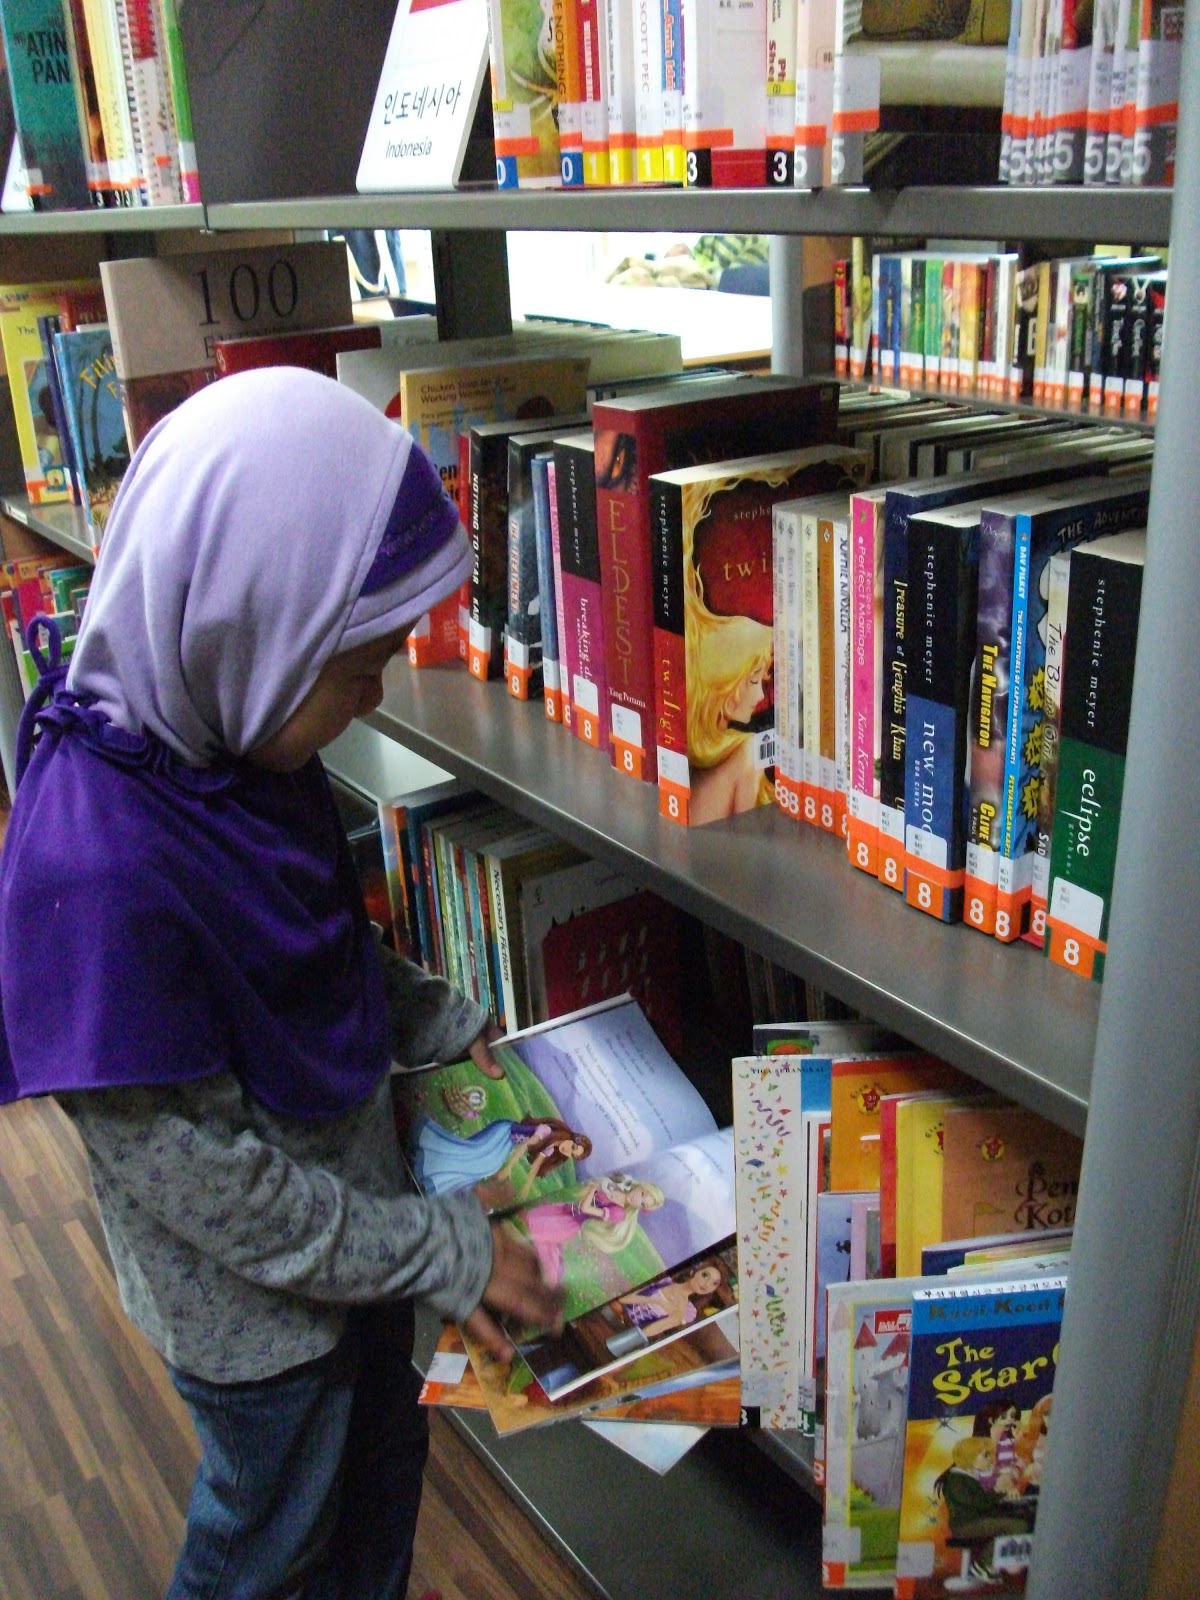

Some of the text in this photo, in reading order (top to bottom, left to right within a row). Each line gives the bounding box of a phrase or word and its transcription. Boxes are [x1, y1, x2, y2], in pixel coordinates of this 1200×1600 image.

[639, 1, 650, 58] SCOTT
[664, 13, 675, 59] Amin
[553, 15, 567, 96] NOTHING
[382, 80, 462, 126] 인도네시아
[385, 136, 433, 160] Indonesia
[664, 149, 675, 179] 1
[794, 144, 807, 177] 5
[831, 138, 845, 174] 5
[1009, 139, 1026, 177] 5
[1053, 131, 1075, 171] 5
[1084, 135, 1105, 176] 5
[1106, 133, 1122, 173] 5
[1133, 131, 1152, 175] 5
[561, 156, 573, 183] 0
[589, 153, 598, 180] 1
[642, 152, 652, 181] 1
[687, 151, 698, 183] 3
[773, 151, 787, 183] 3
[191, 259, 299, 327] 100
[17, 326, 36, 335] The
[420, 382, 455, 394] Chicken
[420, 391, 457, 404] Working
[472, 472, 480, 535] NOTHING
[569, 459, 583, 566] stephenie meyer
[473, 534, 480, 551] TO
[1056, 520, 1084, 543] THE
[510, 518, 520, 616] THE TREATMENT
[660, 495, 671, 618] stephenie meyer
[722, 551, 768, 582] twi
[1020, 545, 1028, 567] DAV
[608, 499, 633, 686] ELDEST
[864, 570, 872, 614] Recipes
[1019, 568, 1028, 600] PILKEY
[855, 546, 867, 666] Perfect Marriage
[924, 545, 937, 685] stephenie meyer
[578, 598, 591, 662] breaking
[1047, 622, 1062, 656] The
[408, 645, 418, 666] 8
[472, 656, 481, 675] 8
[1014, 625, 1023, 677] ADVENTURES
[1086, 579, 1106, 728] stephenie meyer
[510, 676, 520, 695] 8
[890, 579, 908, 761] Treasure of Genghis Khan
[545, 697, 556, 717] 8
[608, 686, 647, 709] Yang Pertama
[977, 644, 999, 749] THE NAVIGATOR
[1012, 687, 1021, 716] CAPTAIN
[583, 719, 593, 740] 8
[1009, 718, 1020, 766] UNDERPANTS
[623, 749, 634, 771] 8
[920, 721, 935, 779] new
[667, 794, 679, 817] 8
[788, 791, 799, 814] 8
[804, 796, 816, 819] 8
[821, 804, 833, 828] 8
[1060, 768, 1102, 858] eclipse
[978, 801, 996, 841] CLIVE
[856, 842, 869, 867] 8
[1037, 832, 1050, 856] SAD
[885, 857, 897, 883] 8
[917, 882, 932, 908] 8
[969, 898, 984, 924] 8
[491, 868, 510, 983] Necessary Fictions
[995, 910, 1010, 937] 8
[1032, 909, 1045, 936] 8
[1063, 938, 1080, 966] 8
[935, 1337, 995, 1368] The
[932, 1355, 1048, 1405] Star
